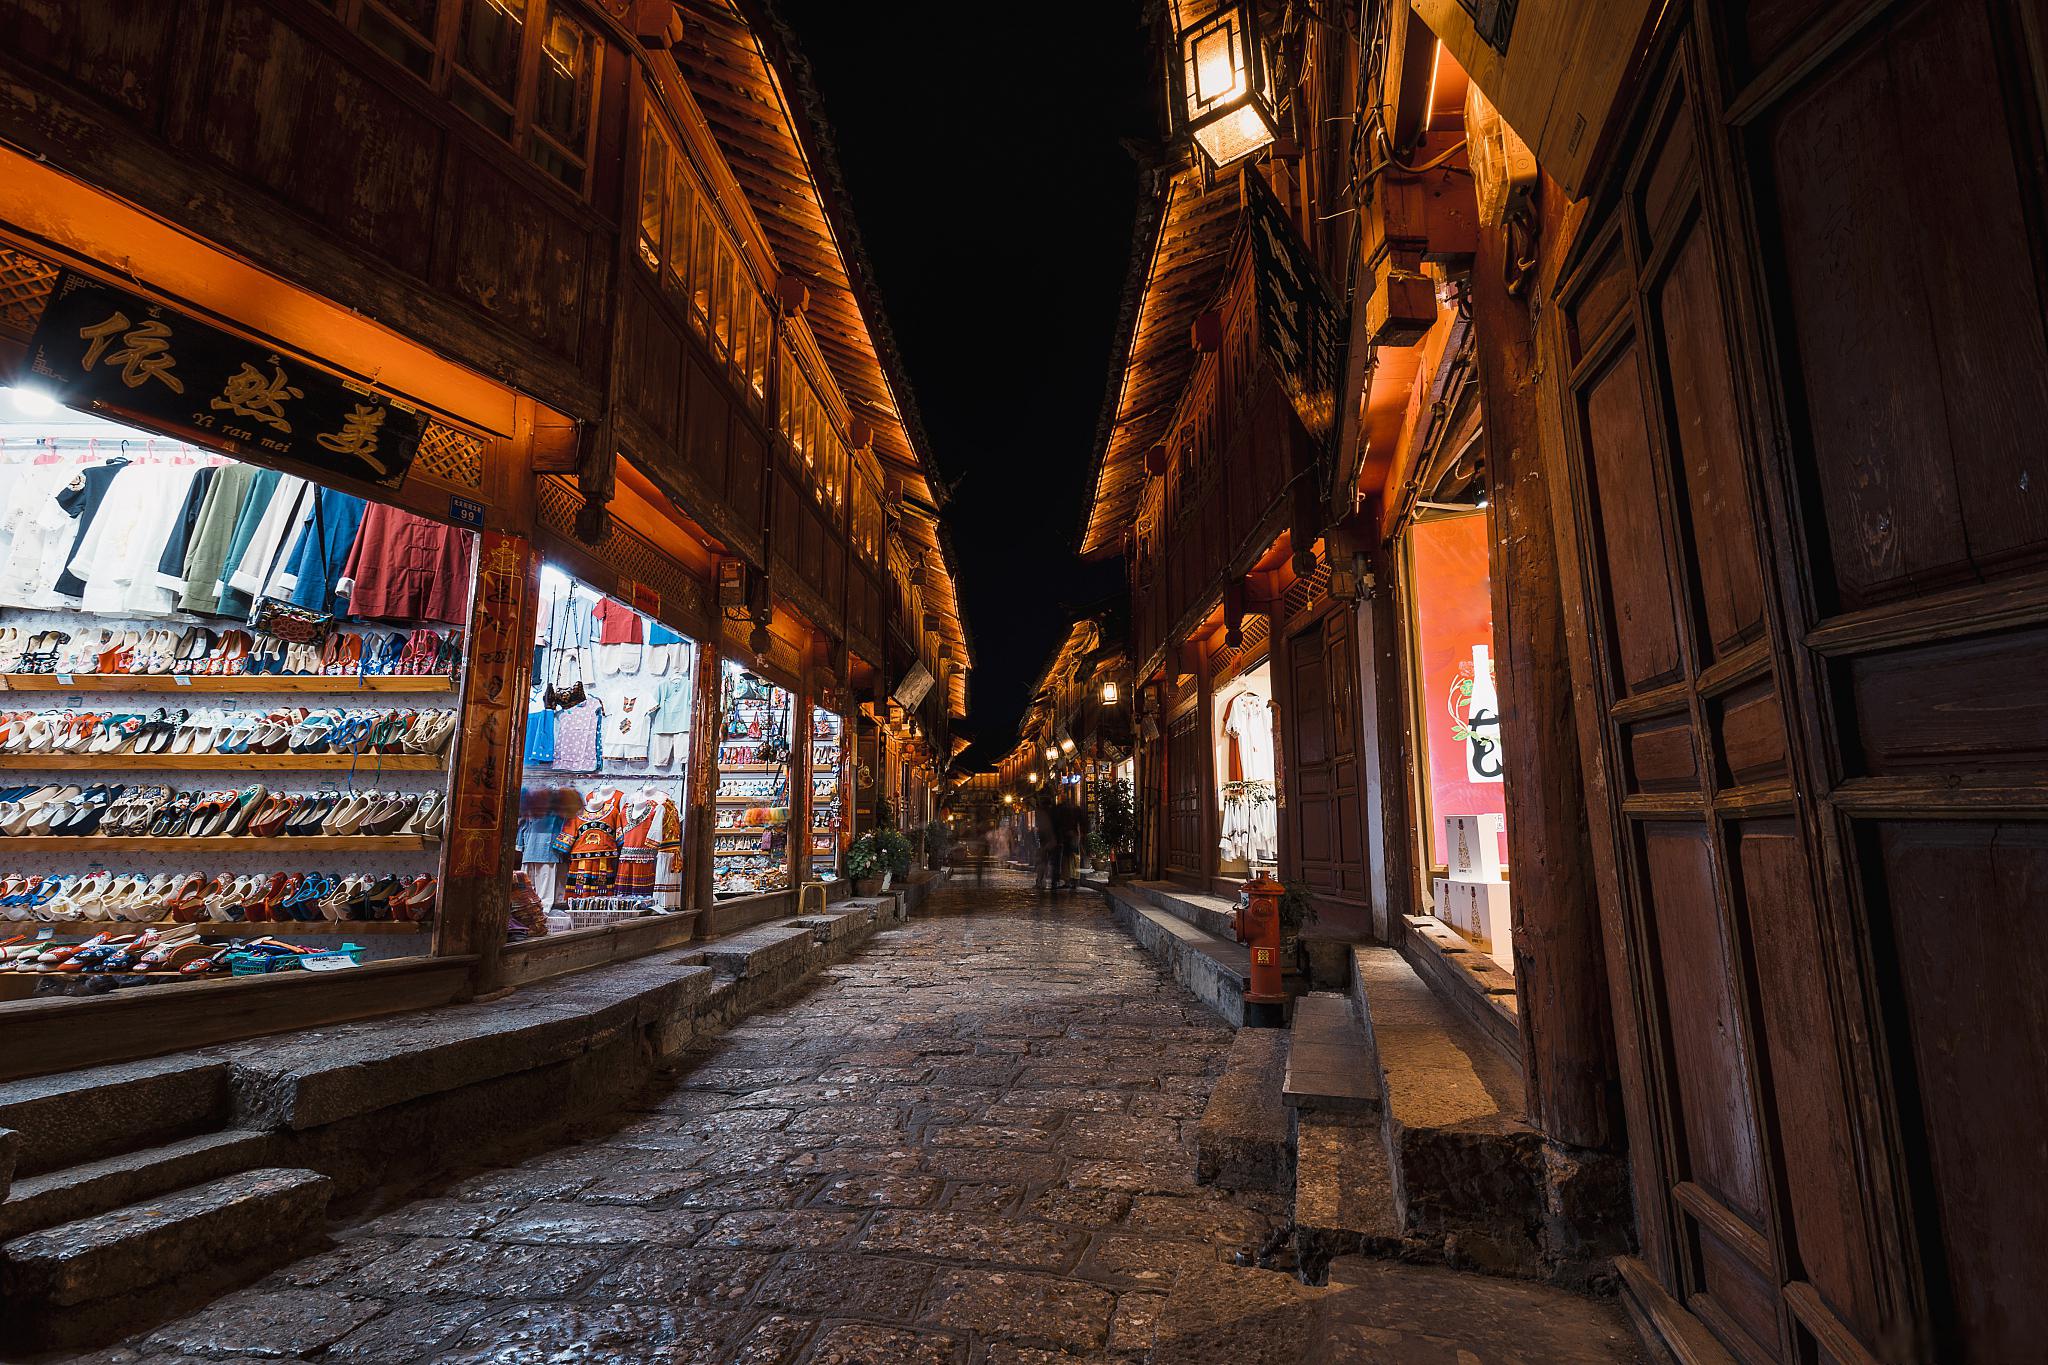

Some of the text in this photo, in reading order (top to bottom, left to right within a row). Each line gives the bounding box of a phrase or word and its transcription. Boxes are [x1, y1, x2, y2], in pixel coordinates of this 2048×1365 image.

[80, 311, 388, 475] 依然美
[192, 413, 293, 453] Yi ran mei
[461, 509, 475, 521] 99
